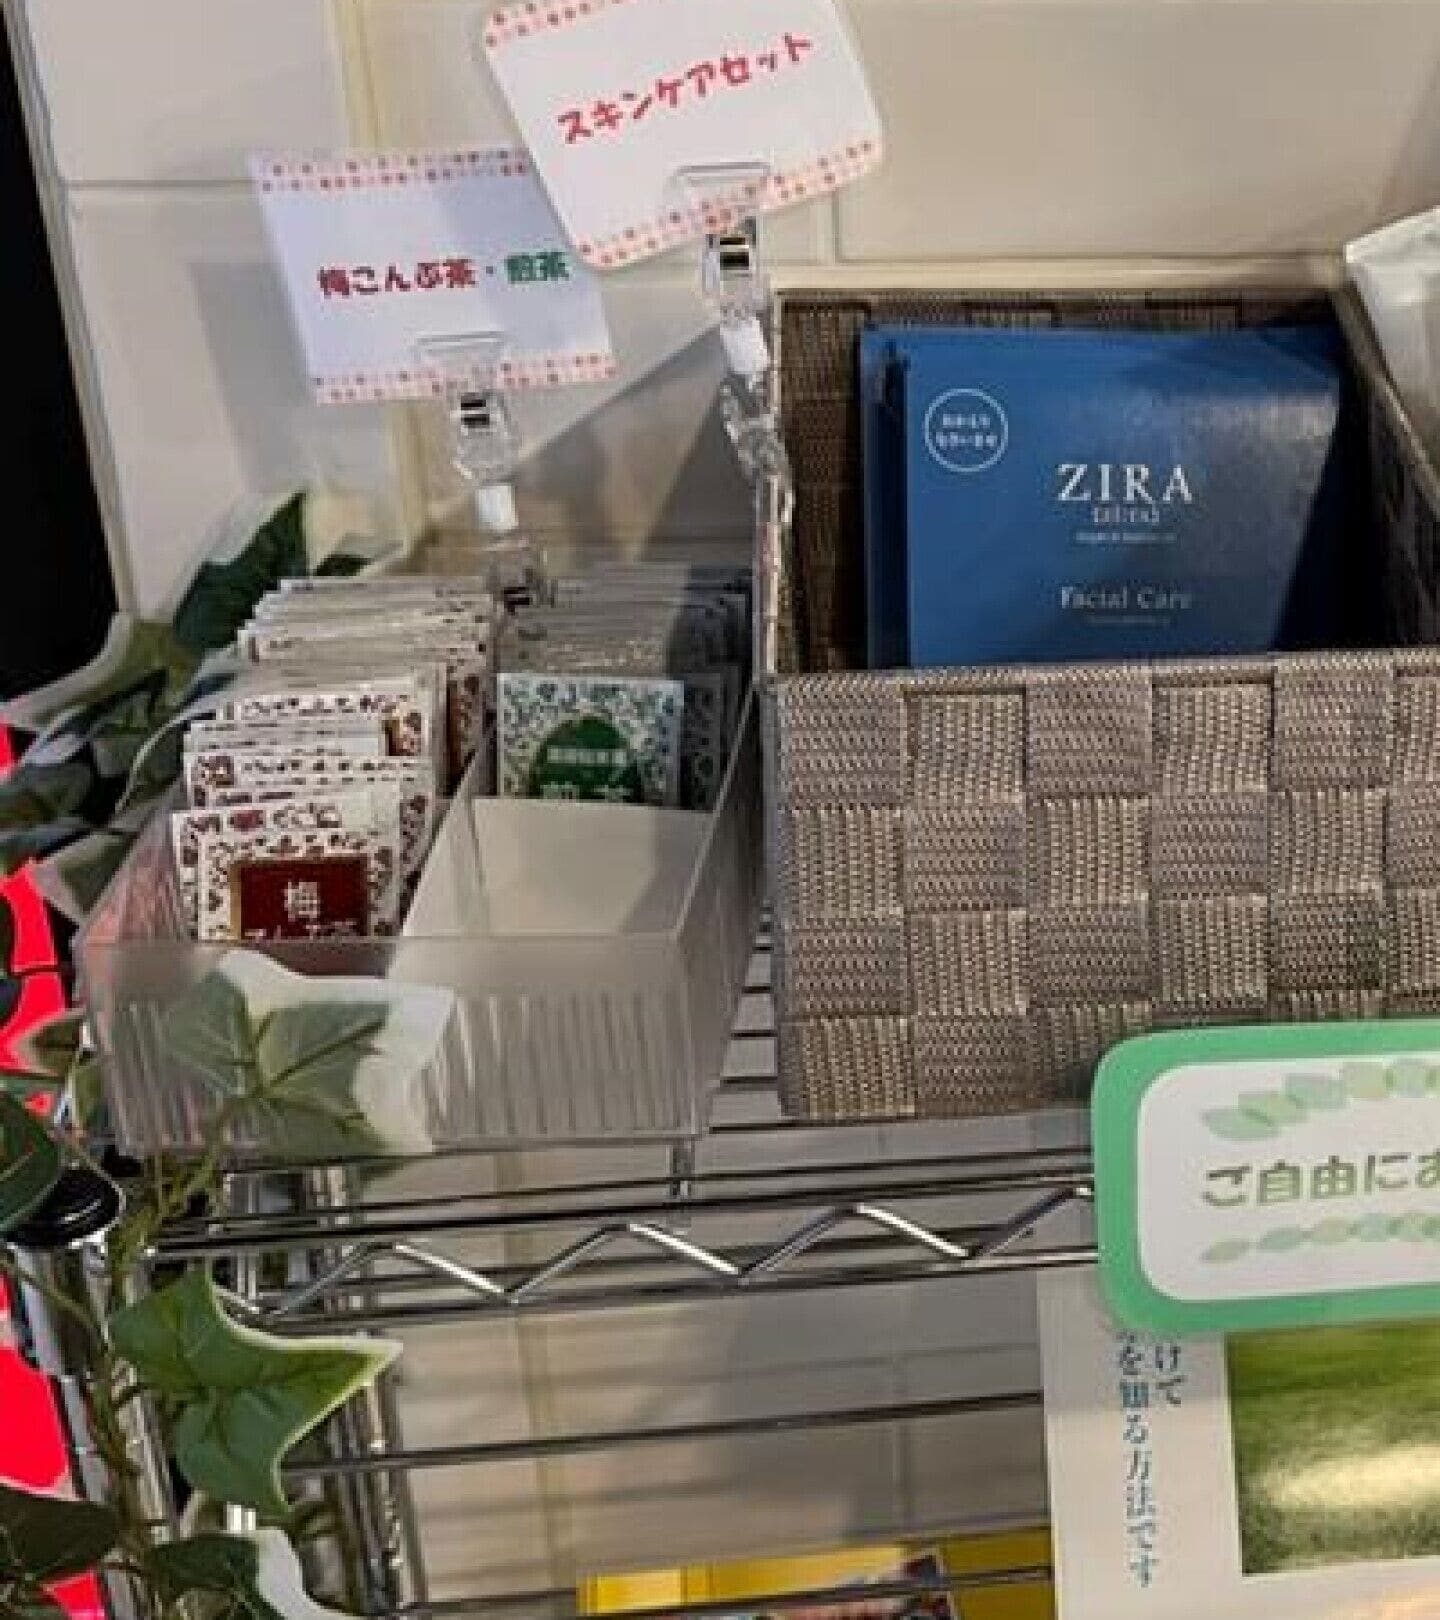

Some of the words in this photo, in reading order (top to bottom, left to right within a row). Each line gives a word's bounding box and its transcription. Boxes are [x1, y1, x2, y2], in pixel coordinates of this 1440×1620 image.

[557, 33, 812, 143] スキンケアセット
[1056, 463, 1193, 504] ZIRA
[1060, 586, 1129, 609] Facial
[1136, 588, 1193, 609] Care
[1118, 1331, 1160, 1588] を知る方法です
